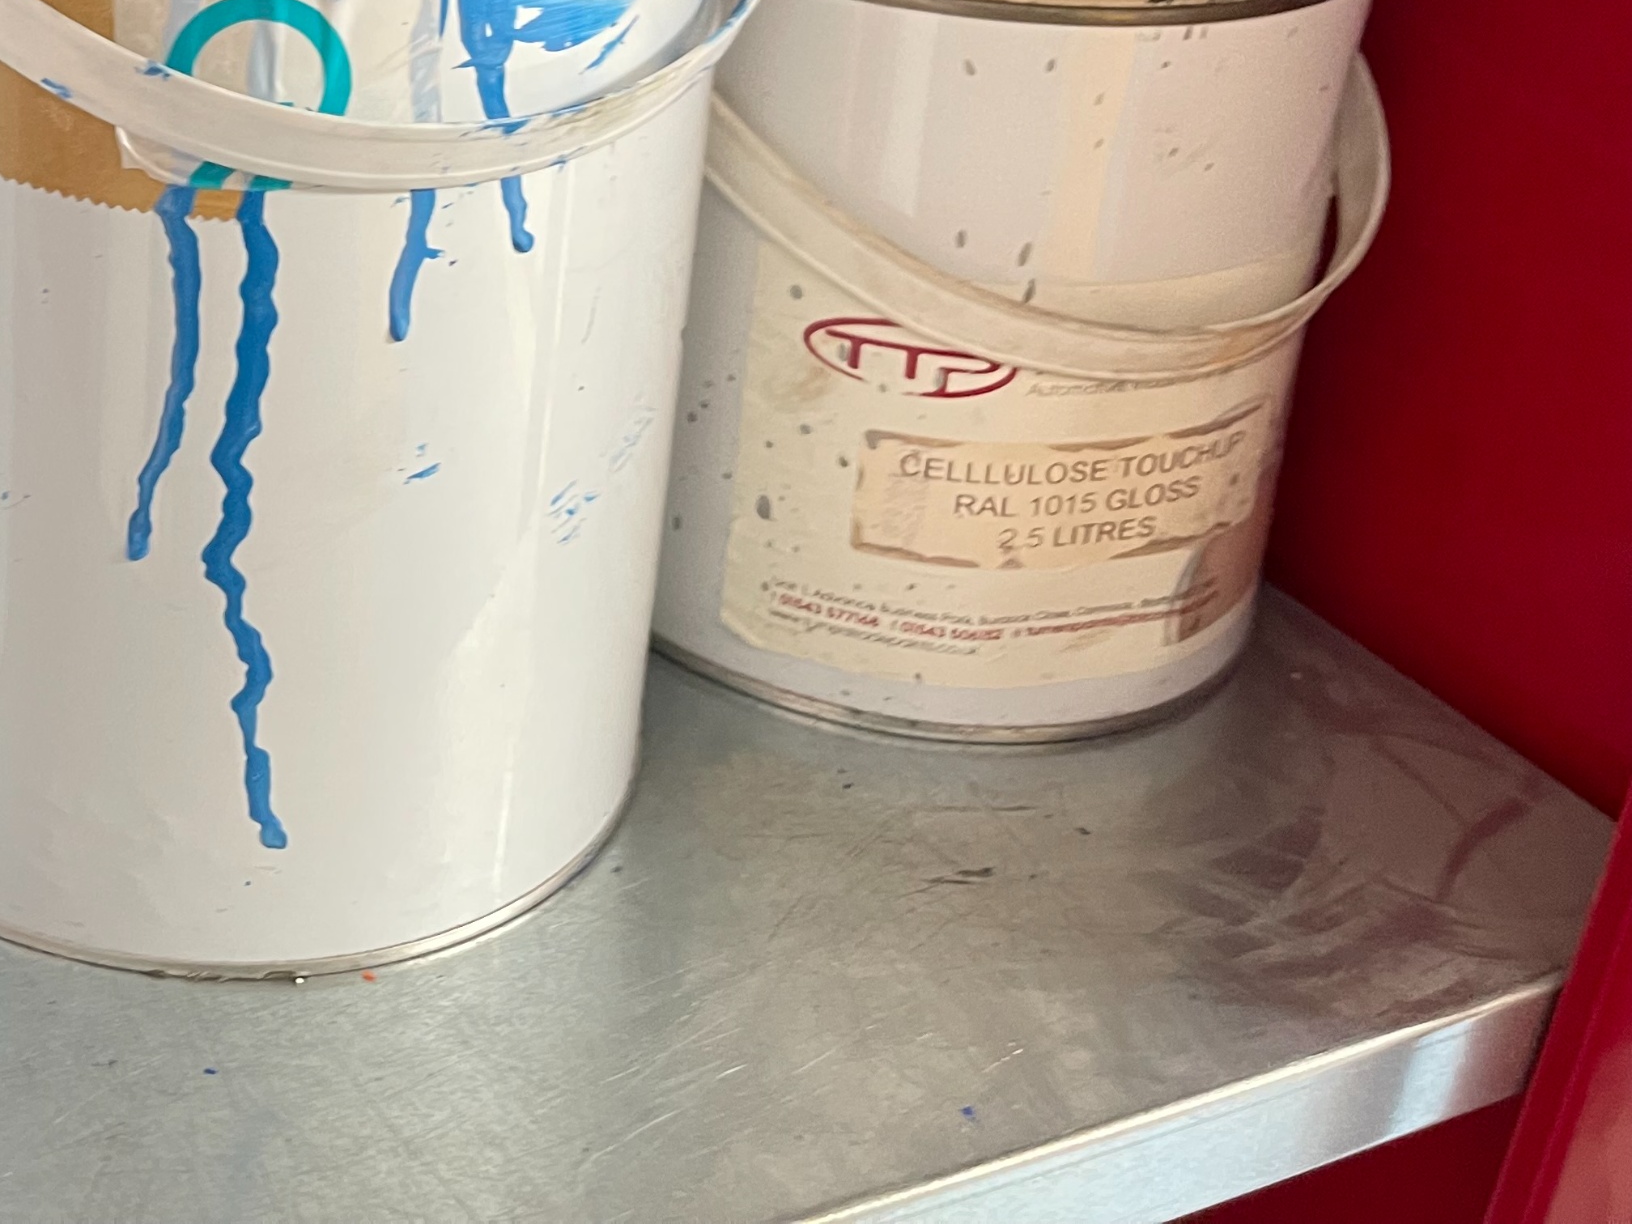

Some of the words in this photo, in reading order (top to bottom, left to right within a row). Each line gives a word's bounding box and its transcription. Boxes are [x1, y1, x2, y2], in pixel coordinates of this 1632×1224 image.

[899, 450, 1107, 485] CELLLULOSE
[953, 493, 1017, 518] RAL
[1030, 492, 1098, 516] 1015
[1105, 475, 1200, 512] GLOSS
[1052, 515, 1157, 548] LITRES
